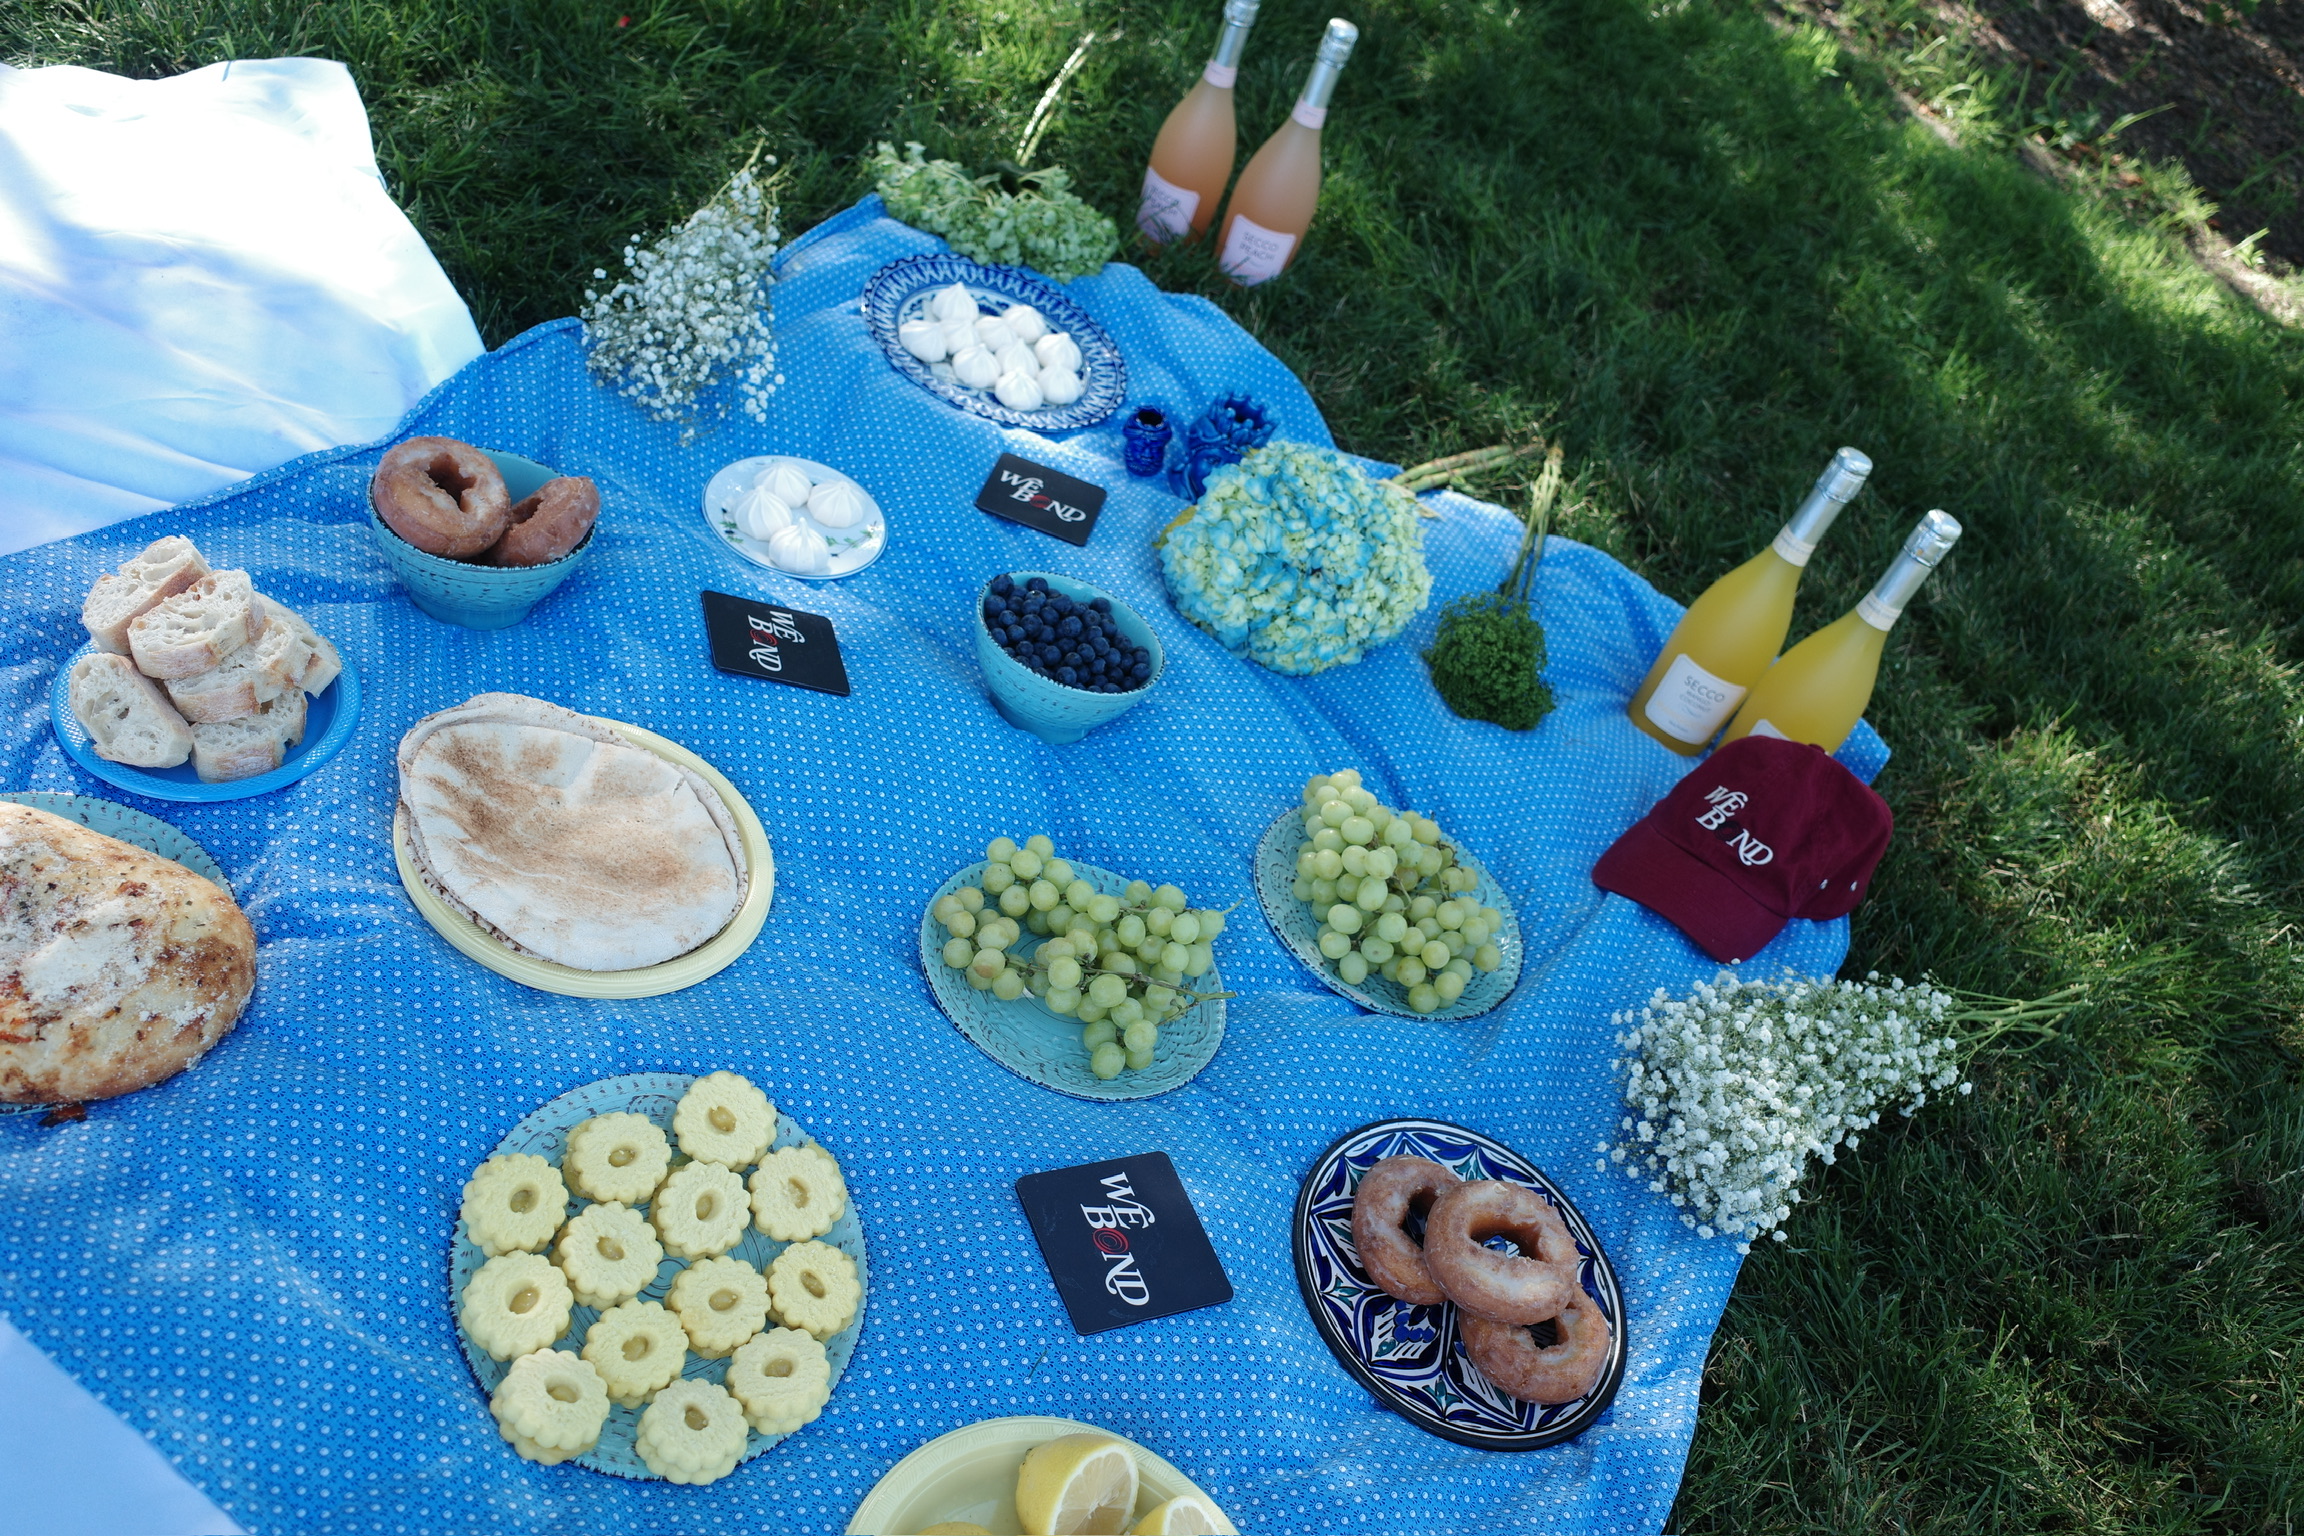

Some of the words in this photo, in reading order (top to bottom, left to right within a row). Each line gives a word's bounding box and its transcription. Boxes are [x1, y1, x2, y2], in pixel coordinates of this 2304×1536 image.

[1000, 469, 1044, 494] WE
[1009, 487, 1087, 523] BOND
[747, 614, 783, 672] BOND
[769, 610, 806, 644] WE
[1684, 675, 1725, 703] SECCO
[1703, 785, 1749, 818] WE
[1100, 1171, 1155, 1230] WE
[1080, 1203, 1150, 1307] BOND
